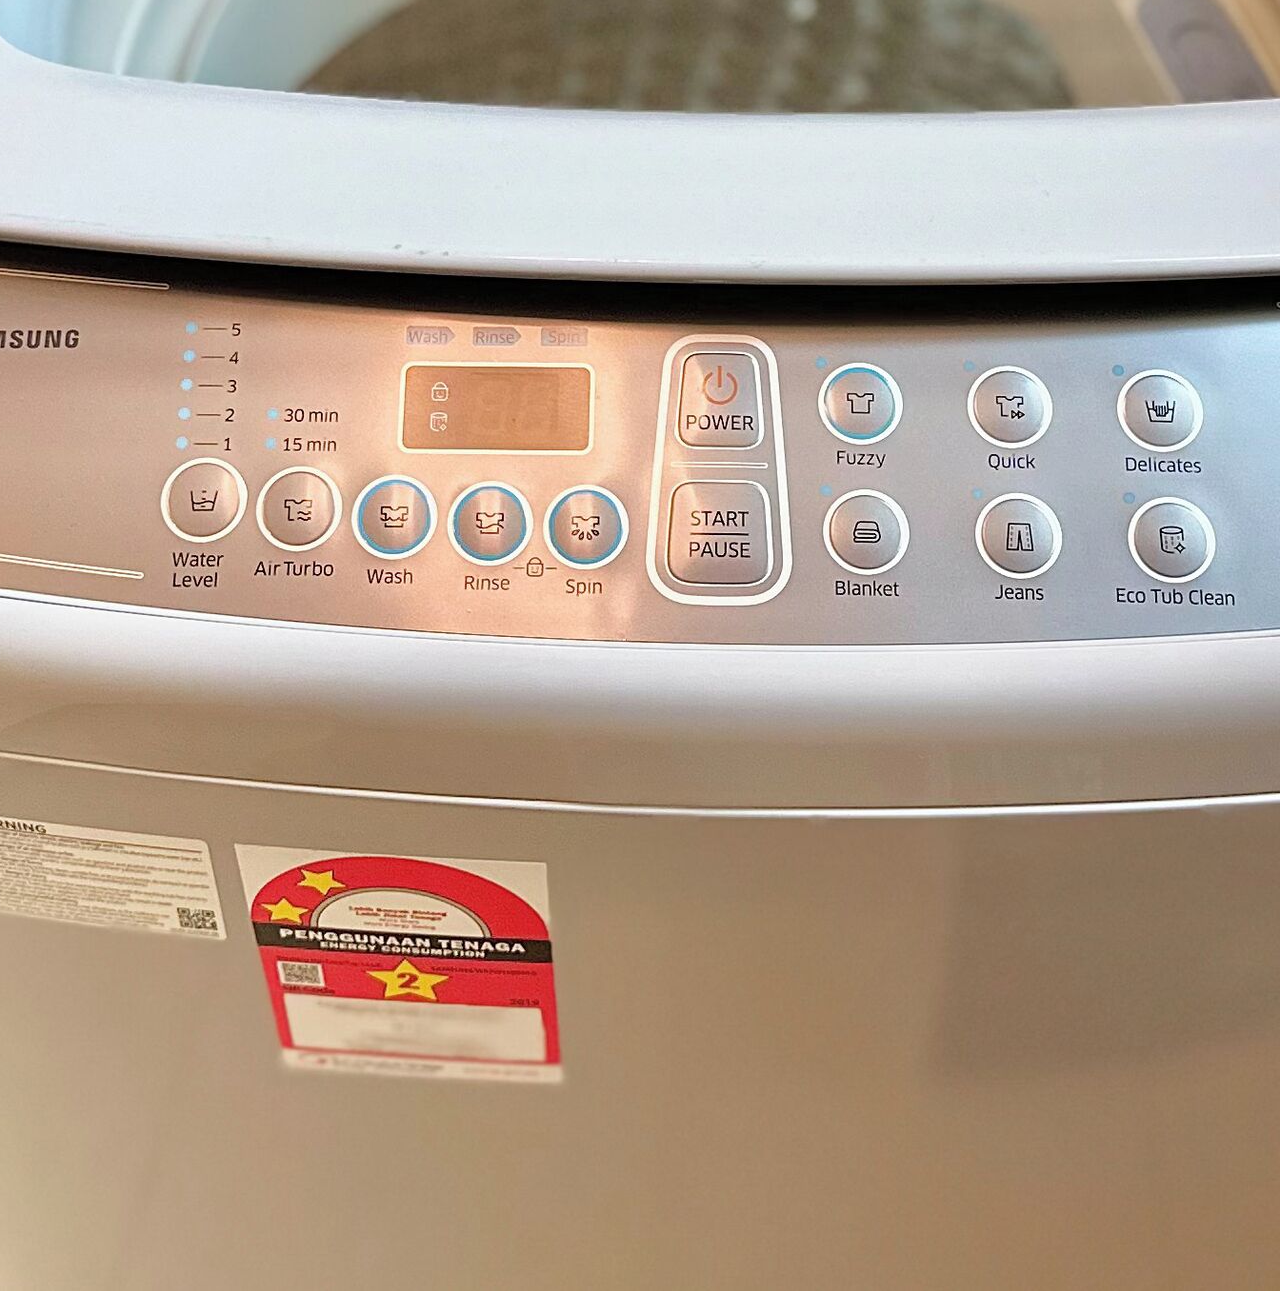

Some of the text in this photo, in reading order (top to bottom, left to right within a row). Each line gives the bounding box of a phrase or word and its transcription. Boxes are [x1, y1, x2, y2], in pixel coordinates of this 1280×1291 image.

[231, 323, 241, 337] 5
[407, 329, 448, 344] Wash
[475, 331, 515, 345] Rinse
[228, 351, 239, 365] 4
[226, 379, 237, 393] 3
[224, 408, 235, 422] 2
[283, 408, 339, 423] 30 min
[685, 413, 754, 431] POWER
[223, 437, 232, 451] 1
[283, 437, 337, 452] 15 min
[836, 450, 886, 469] Fuzzy
[987, 452, 1036, 472] Quick
[1124, 456, 1202, 474] Delicates
[690, 510, 749, 528] START
[688, 542, 751, 559] PAUSE
[172, 551, 224, 568] Water
[253, 560, 335, 577] Air Turbo
[366, 568, 414, 585] Wash
[172, 571, 218, 588] Level
[463, 574, 510, 591] Rinse
[565, 578, 603, 597] Spin
[834, 580, 900, 598] Blanket
[994, 584, 1045, 602] Jeans
[1115, 587, 1236, 607] Eco Tub Clean
[279, 927, 526, 953] PENGGUNAAN TENAGA
[320, 941, 486, 959] ENERGY CONSUMPTION
[396, 972, 420, 990] 2
